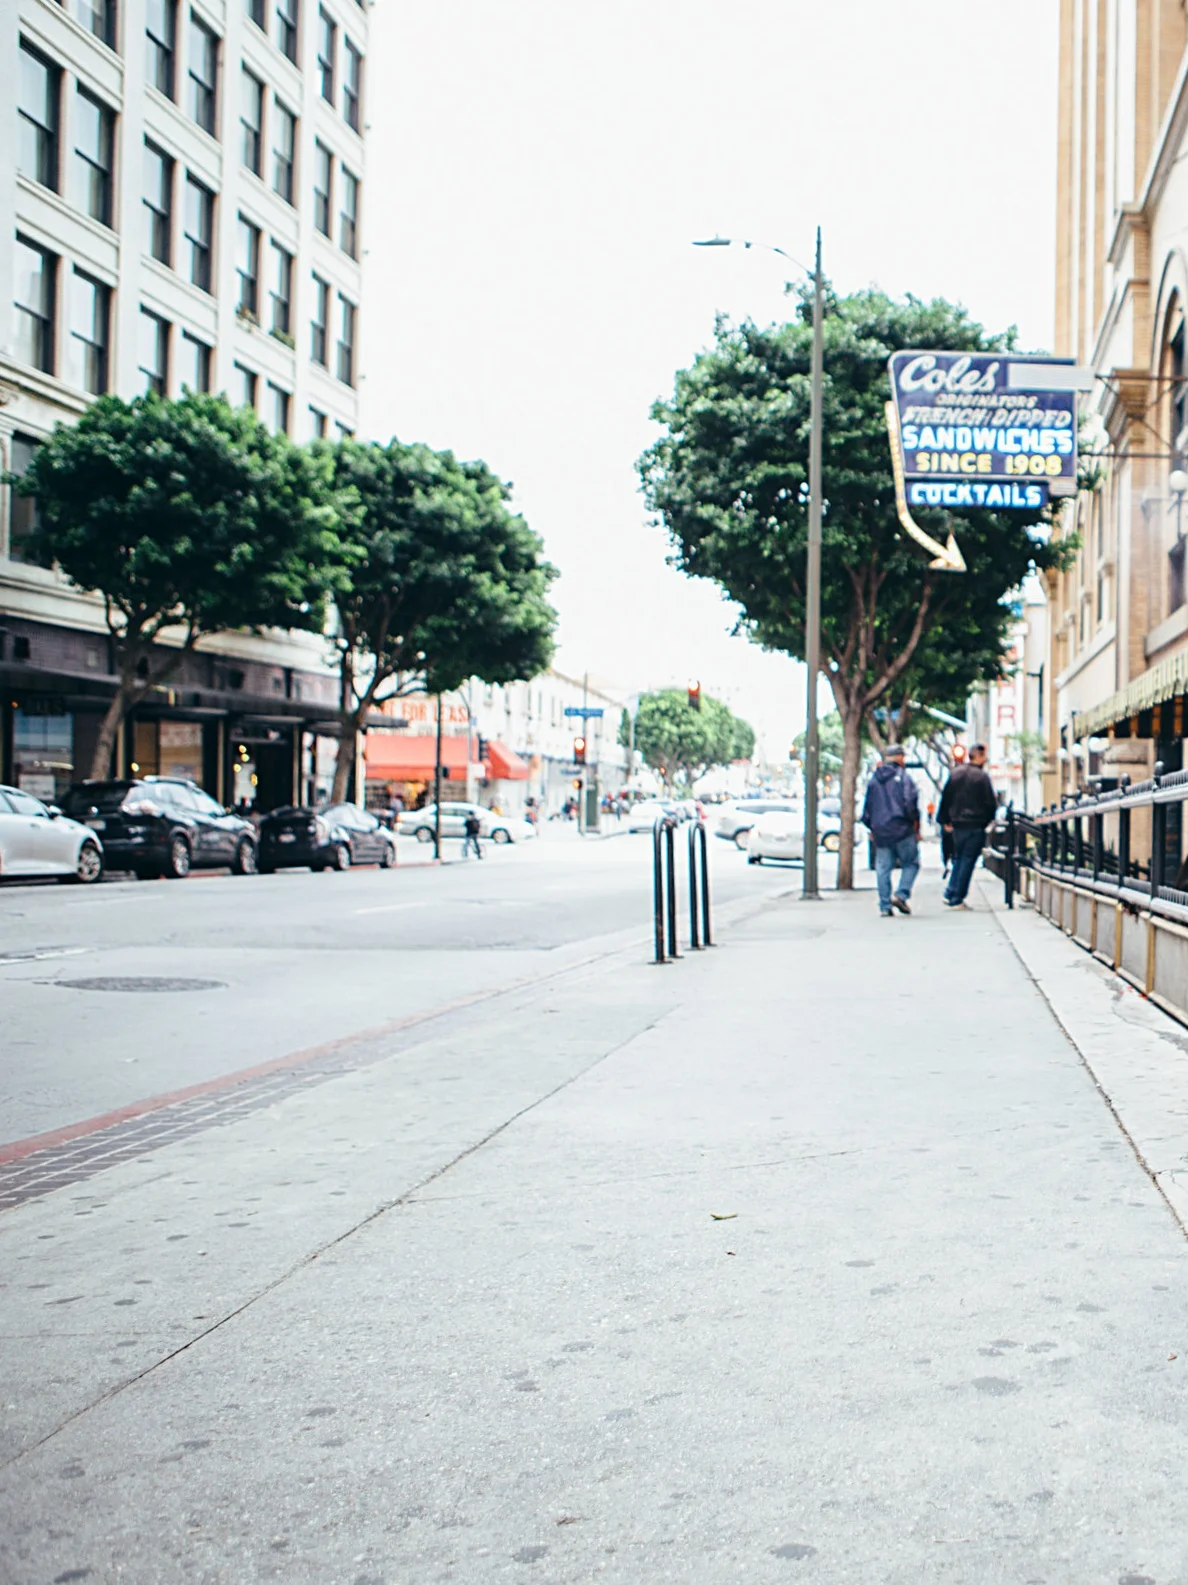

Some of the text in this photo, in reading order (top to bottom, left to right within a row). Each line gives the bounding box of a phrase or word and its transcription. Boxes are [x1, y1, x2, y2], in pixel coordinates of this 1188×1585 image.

[899, 355, 1000, 393] Coles
[936, 393, 1038, 409] ORIGINATORS
[901, 405, 1073, 428] FRENCH DIPPED
[902, 424, 1074, 454] SANDWICHES
[915, 452, 1063, 476] SINCE 1908
[910, 483, 1042, 507] COCKTAILS
